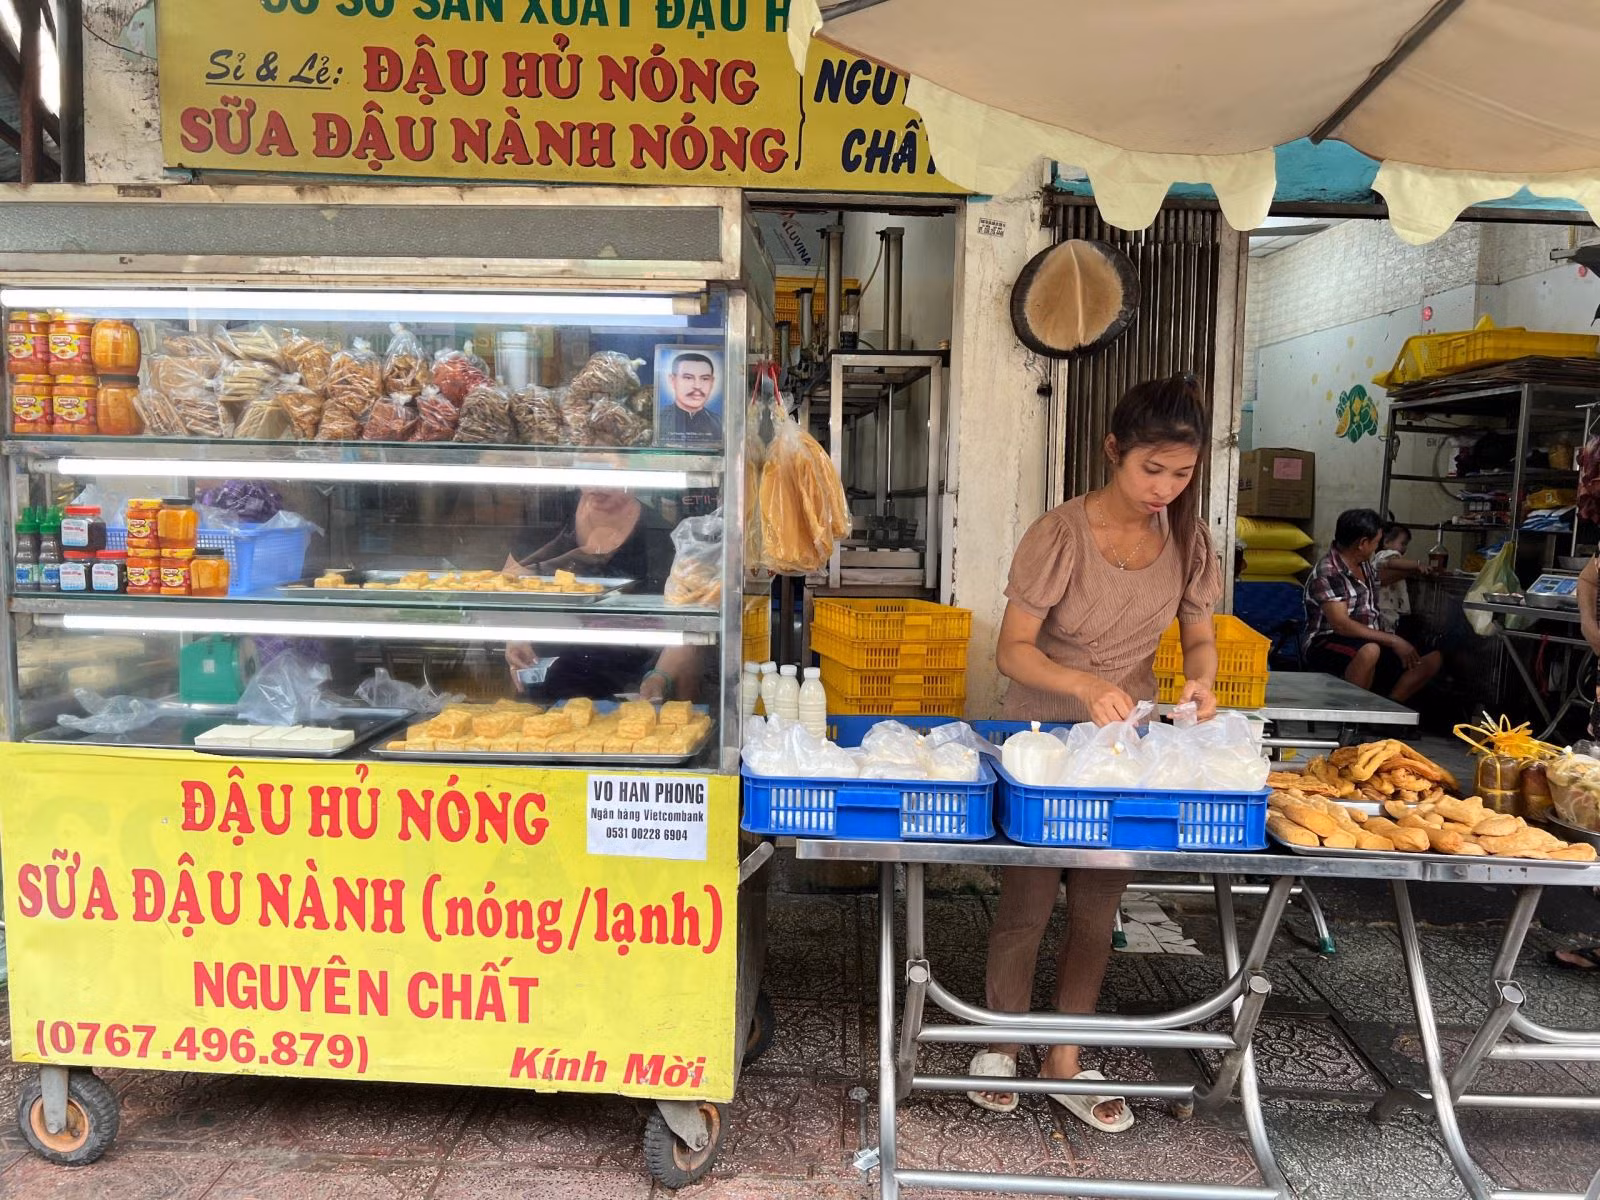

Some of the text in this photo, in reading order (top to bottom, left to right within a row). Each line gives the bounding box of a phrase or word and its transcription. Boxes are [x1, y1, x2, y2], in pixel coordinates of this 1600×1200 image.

[764, 0, 789, 32] H
[205, 33, 760, 106] Sỉ & Lẻ: ĐẬU HỦ NÓNG
[180, 94, 789, 173] SỮA ĐẬU NÀNH NÓNG
[181, 764, 550, 846] ĐẬU HỦ NÓNG
[590, 807, 704, 822] Ngân hàng Vietcombank
[593, 780, 705, 805] VO HAN PHONG
[606, 827, 688, 841] 0531 00228 6904
[18, 848, 119, 920] SỮA
[131, 851, 243, 938] ĐẬU
[256, 858, 406, 934] NÀNH
[193, 955, 540, 1024] NGUYÊN CHẤT
[36, 1020, 369, 1074] (0767.496.879)
[509, 1047, 707, 1089] Kính Mời
